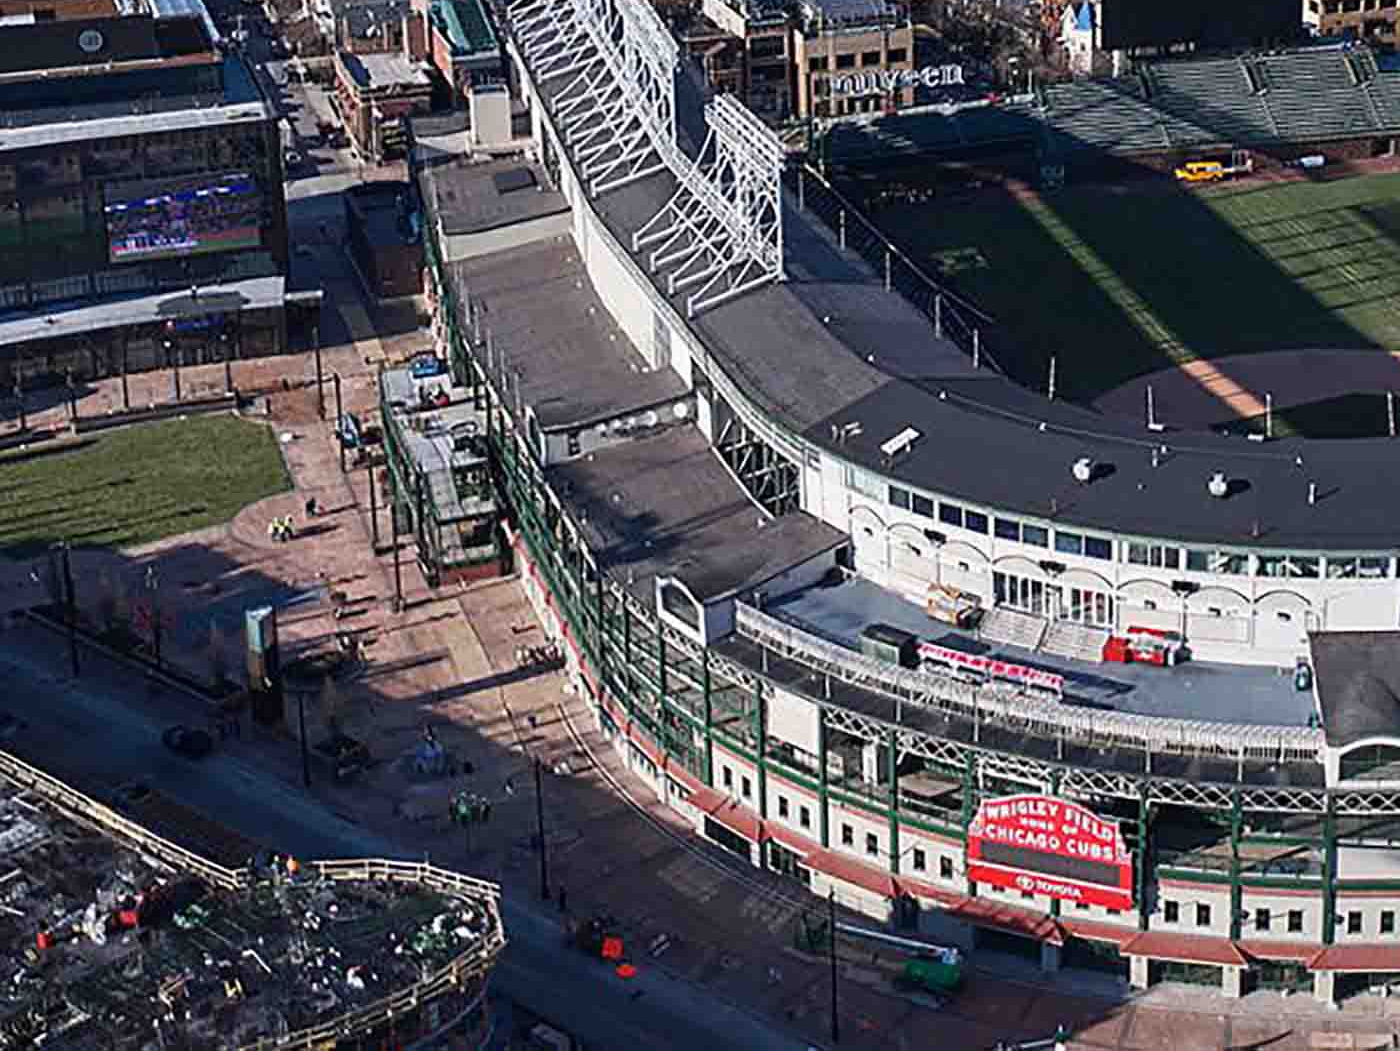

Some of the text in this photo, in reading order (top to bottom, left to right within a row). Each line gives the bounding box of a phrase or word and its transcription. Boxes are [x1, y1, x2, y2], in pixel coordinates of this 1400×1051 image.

[987, 801, 1113, 841] WRIGLEY FIELD
[986, 825, 1113, 859] CHICAGO CUBS
